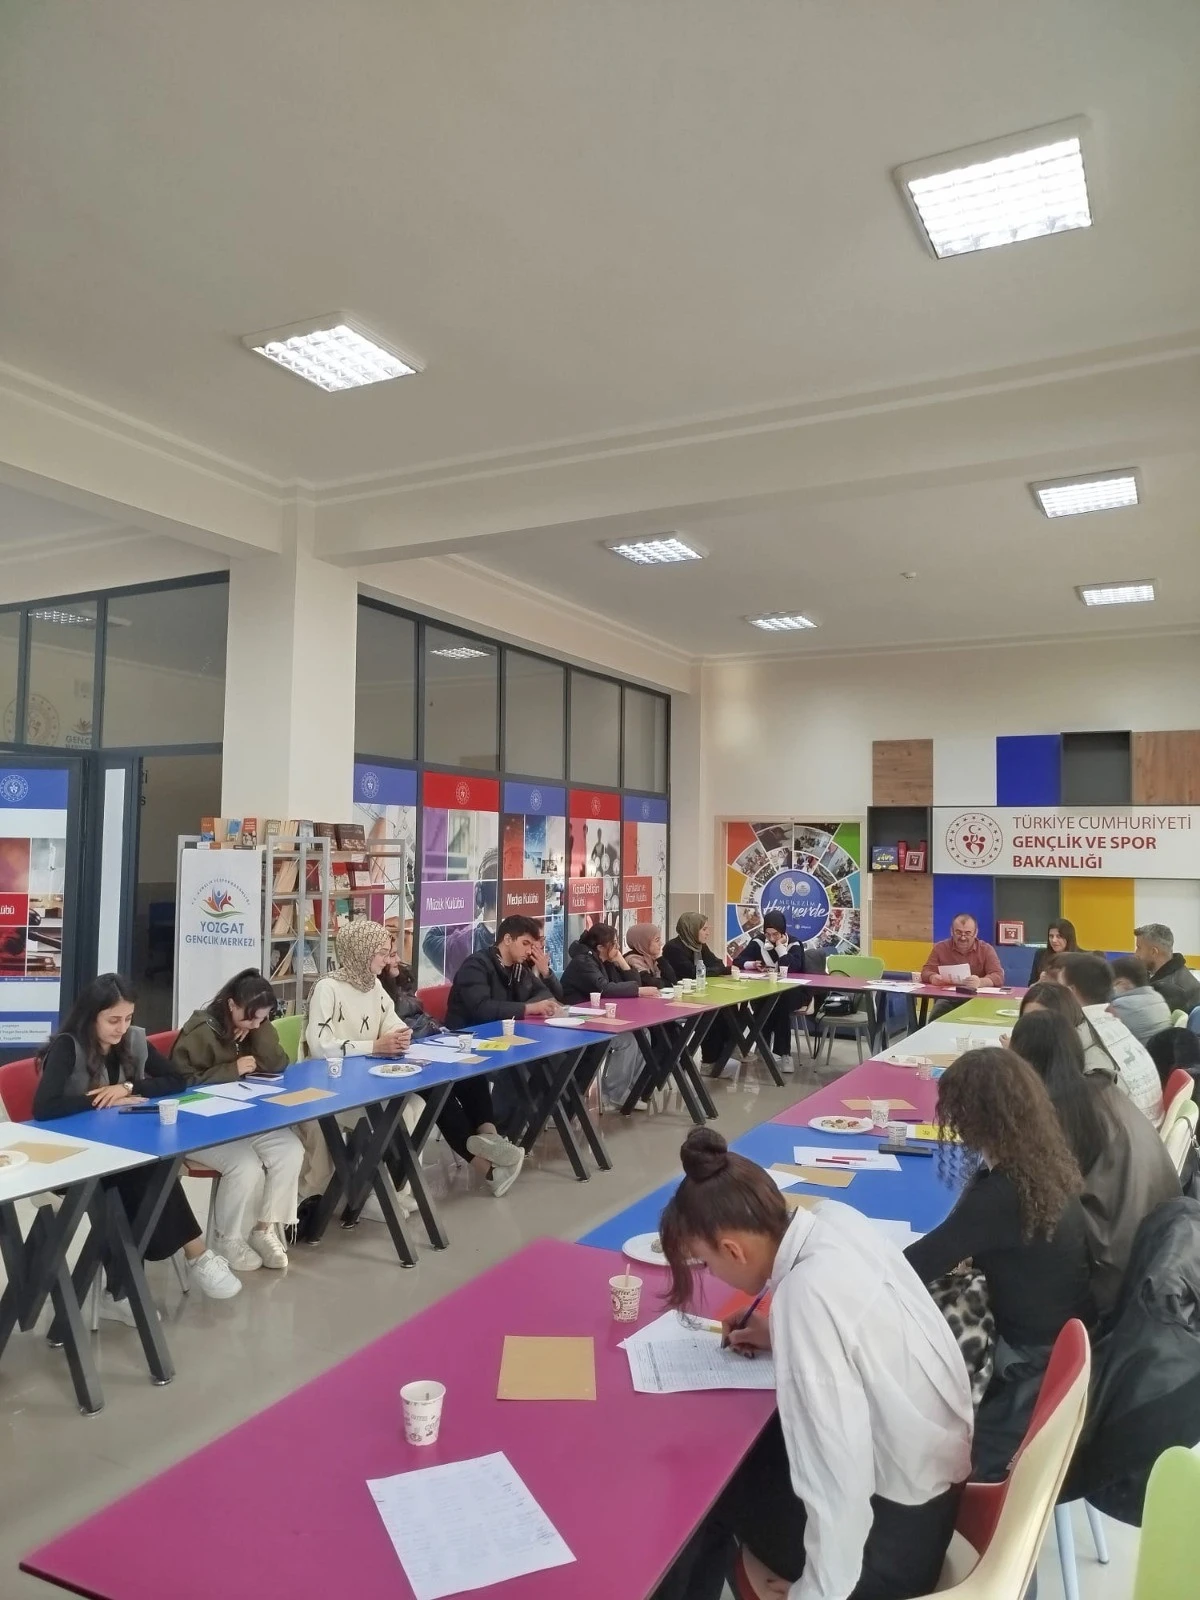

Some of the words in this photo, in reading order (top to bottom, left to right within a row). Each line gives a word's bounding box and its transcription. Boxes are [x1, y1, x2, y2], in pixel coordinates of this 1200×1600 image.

[1012, 815, 1075, 830] TÜRKİYE
[1078, 814, 1192, 830] CUMHURİYETİ
[1012, 834, 1082, 851] GENÇLİK
[1085, 836, 1107, 849] VE
[1110, 836, 1157, 850] SPOR
[1012, 853, 1103, 869] BAKANLIĞI
[426, 897, 444, 911] Müzik
[506, 893, 522, 906] Medya
[200, 921, 244, 934] YOZGAT
